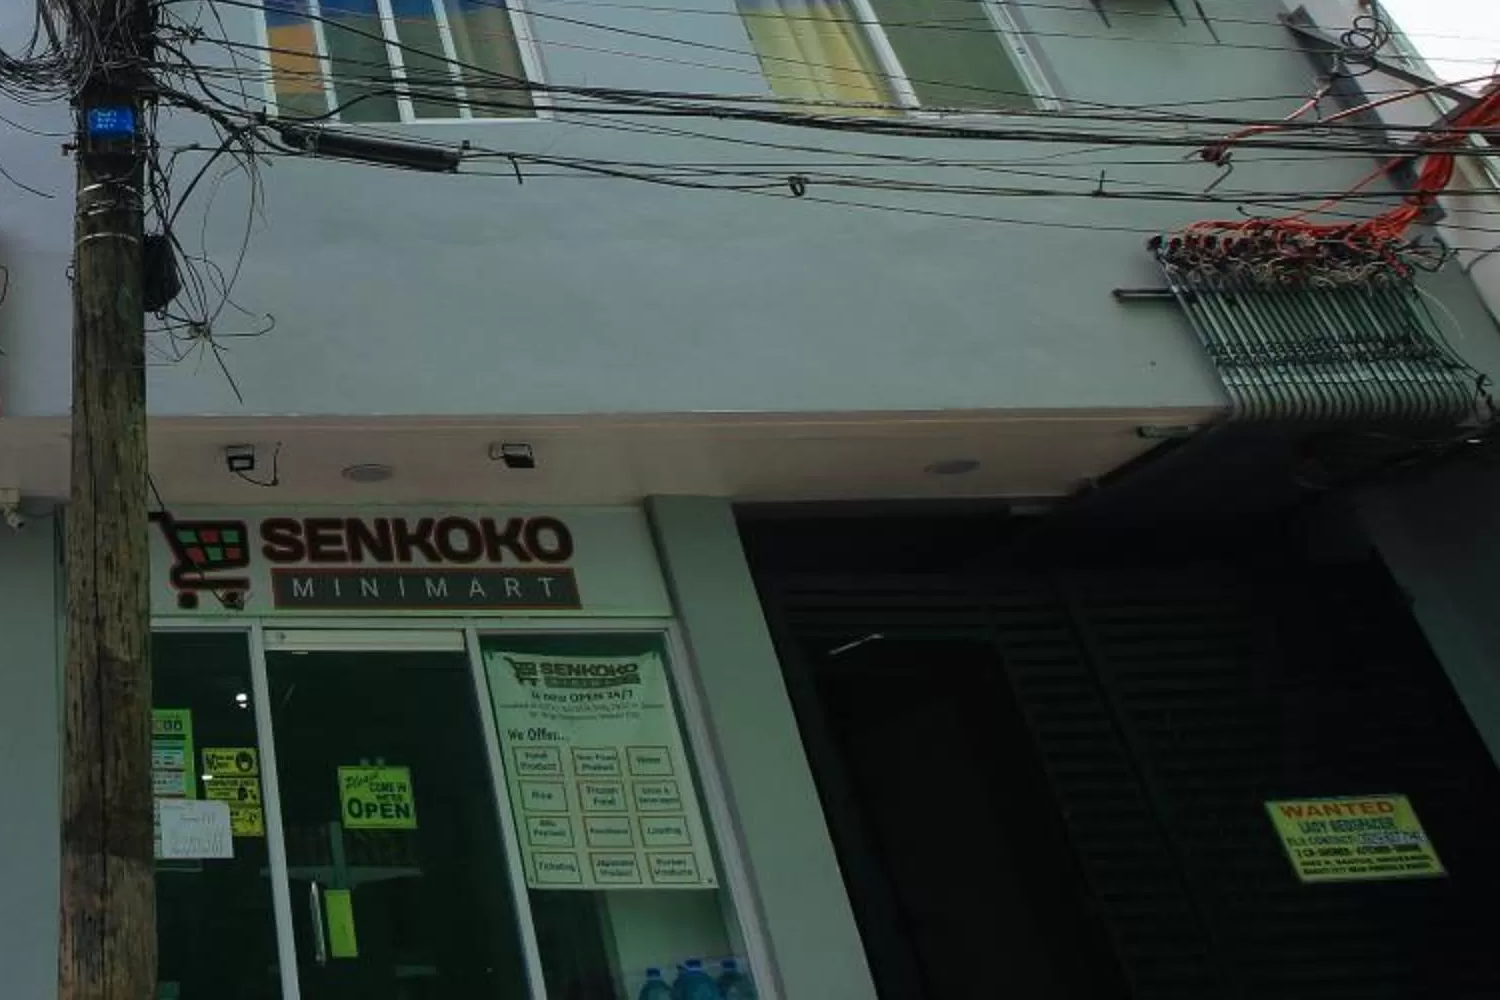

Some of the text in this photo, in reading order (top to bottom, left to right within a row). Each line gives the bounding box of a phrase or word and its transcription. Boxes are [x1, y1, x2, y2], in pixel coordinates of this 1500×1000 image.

[259, 516, 574, 564] SENKOKO
[292, 577, 558, 599] MINIMART
[540, 662, 639, 678] SENKOKO
[569, 692, 604, 703] OPEN
[507, 729, 524, 742] We
[347, 797, 411, 819] OPEN
[1279, 800, 1395, 819] WANTED
